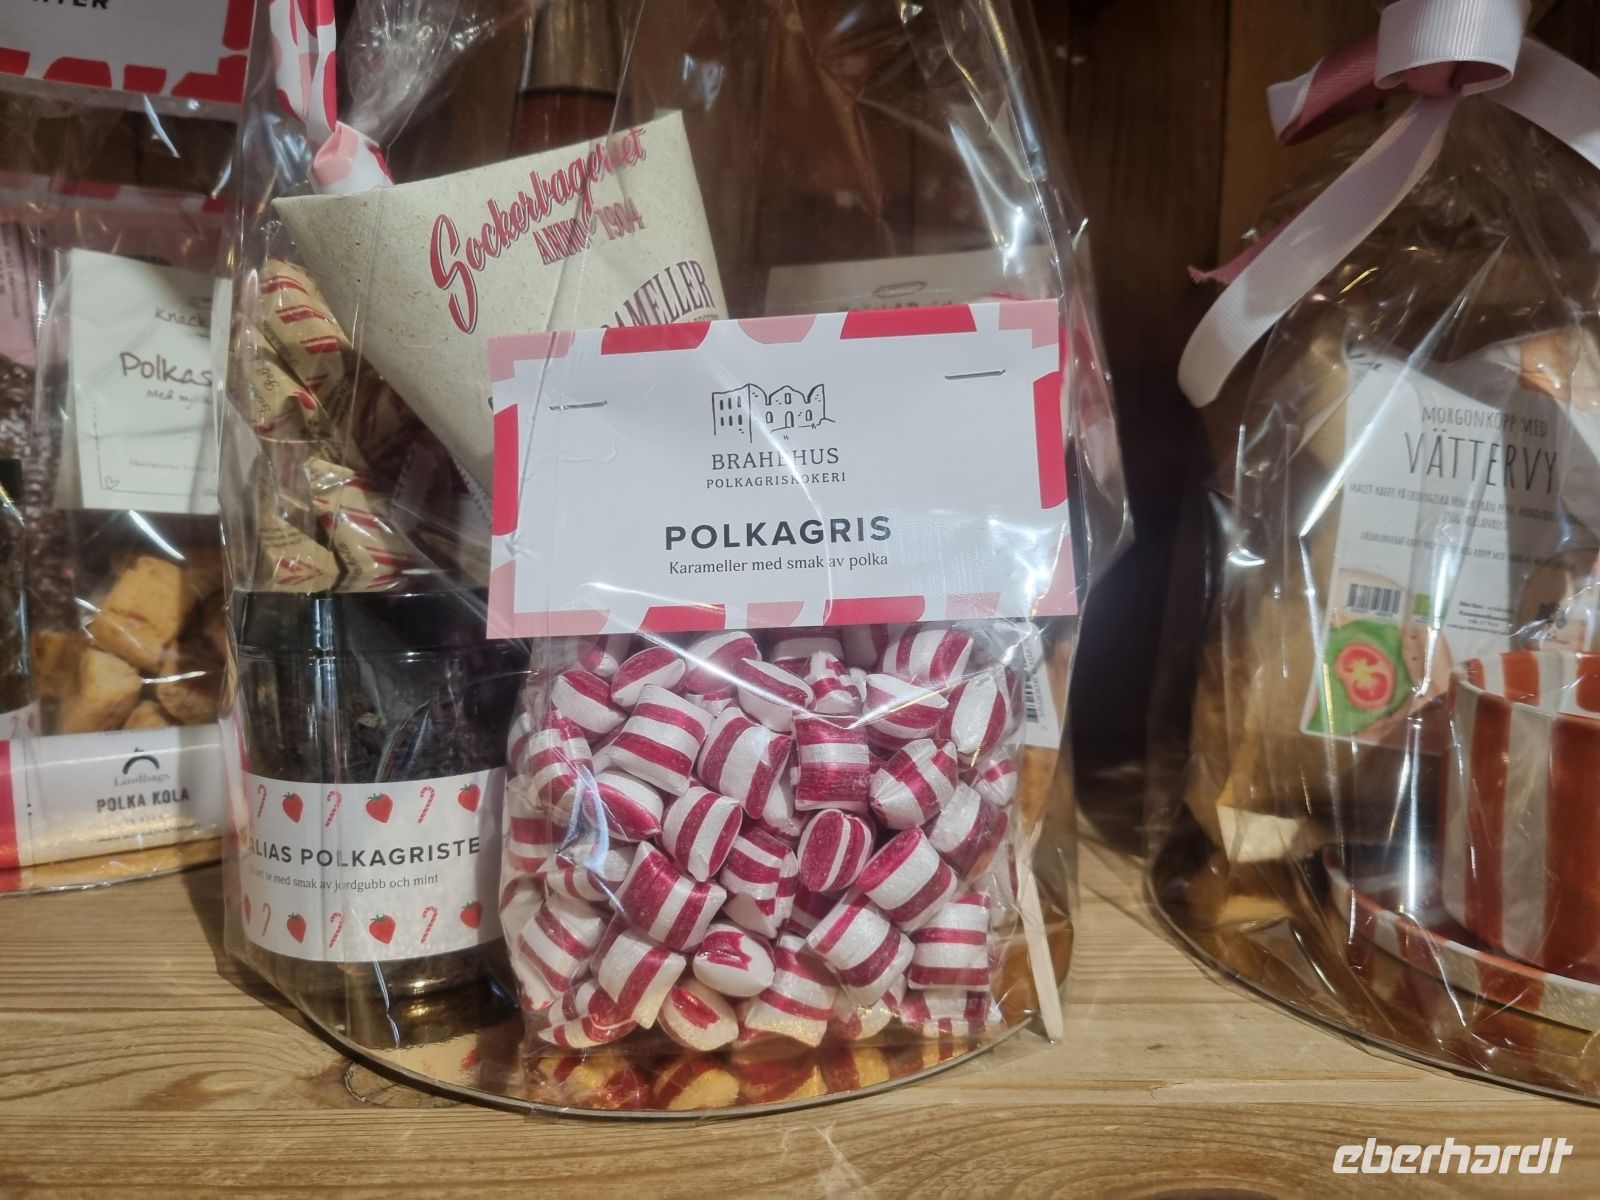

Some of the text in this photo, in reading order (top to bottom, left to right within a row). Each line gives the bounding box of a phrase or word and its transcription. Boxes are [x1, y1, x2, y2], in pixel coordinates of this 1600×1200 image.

[532, 197, 646, 265] ANNO 1904
[1422, 406, 1548, 438] MORGONKOPP MED
[711, 447, 840, 471] BRAHEHUS
[1404, 428, 1557, 495] VÄTTERVY
[706, 472, 847, 489] POLKAGRISKOKERI
[665, 515, 892, 551] POLKAGRIS
[669, 552, 888, 575] Karameller med smak av polka
[96, 787, 190, 813] POLKA KOLA
[300, 836, 481, 868] POLKAGRISTE
[274, 874, 291, 886] med
[293, 878, 318, 889] smak
[320, 880, 333, 889] av
[334, 878, 386, 893] jordgubb
[389, 876, 410, 889] och
[413, 873, 439, 886] mint
